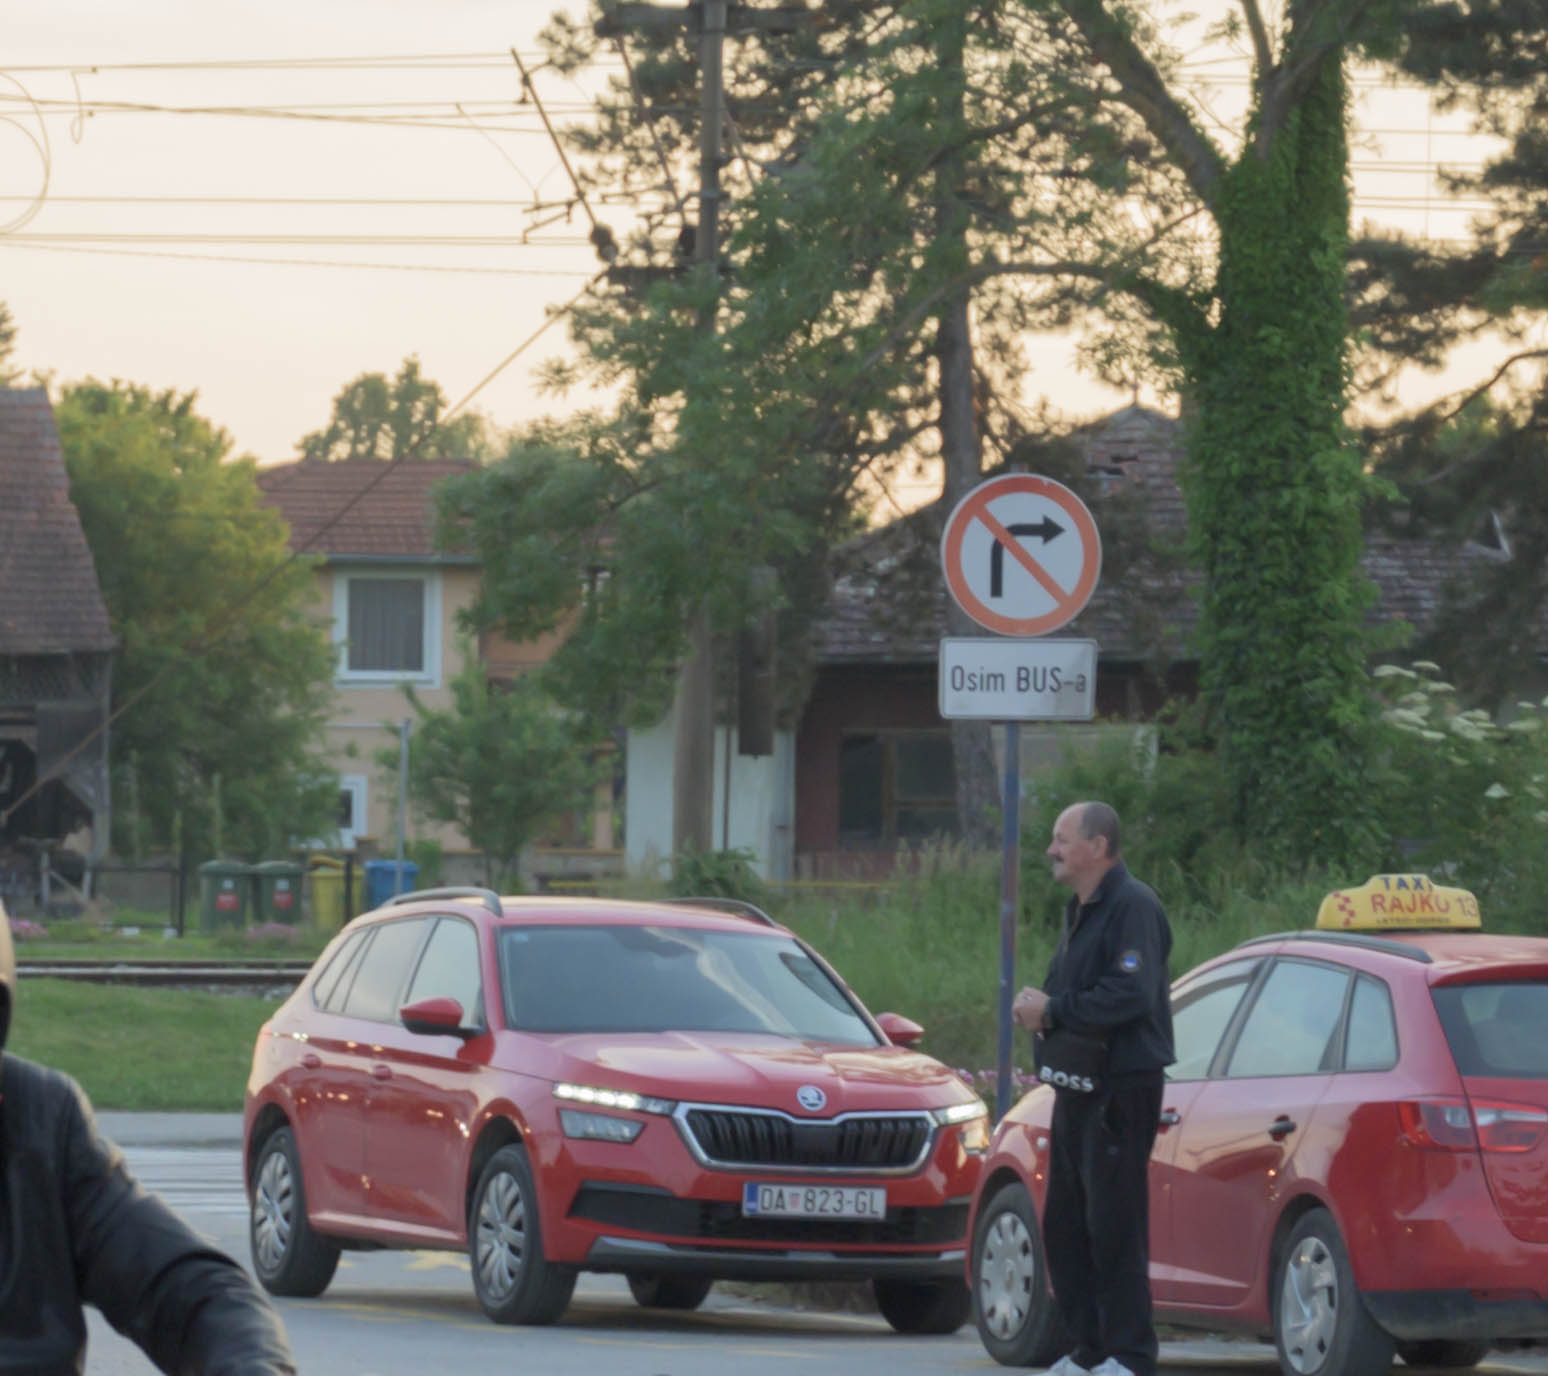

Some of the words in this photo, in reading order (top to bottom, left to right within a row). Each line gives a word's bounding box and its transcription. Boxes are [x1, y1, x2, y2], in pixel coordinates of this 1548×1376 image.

[951, 665, 1005, 692] Osim
[1016, 665, 1087, 693] BUS-a
[1380, 876, 1433, 892] TAXI
[1040, 1065, 1095, 1093] BOSS
[760, 1187, 786, 1211] DA
[804, 1188, 880, 1214] 823-GL
